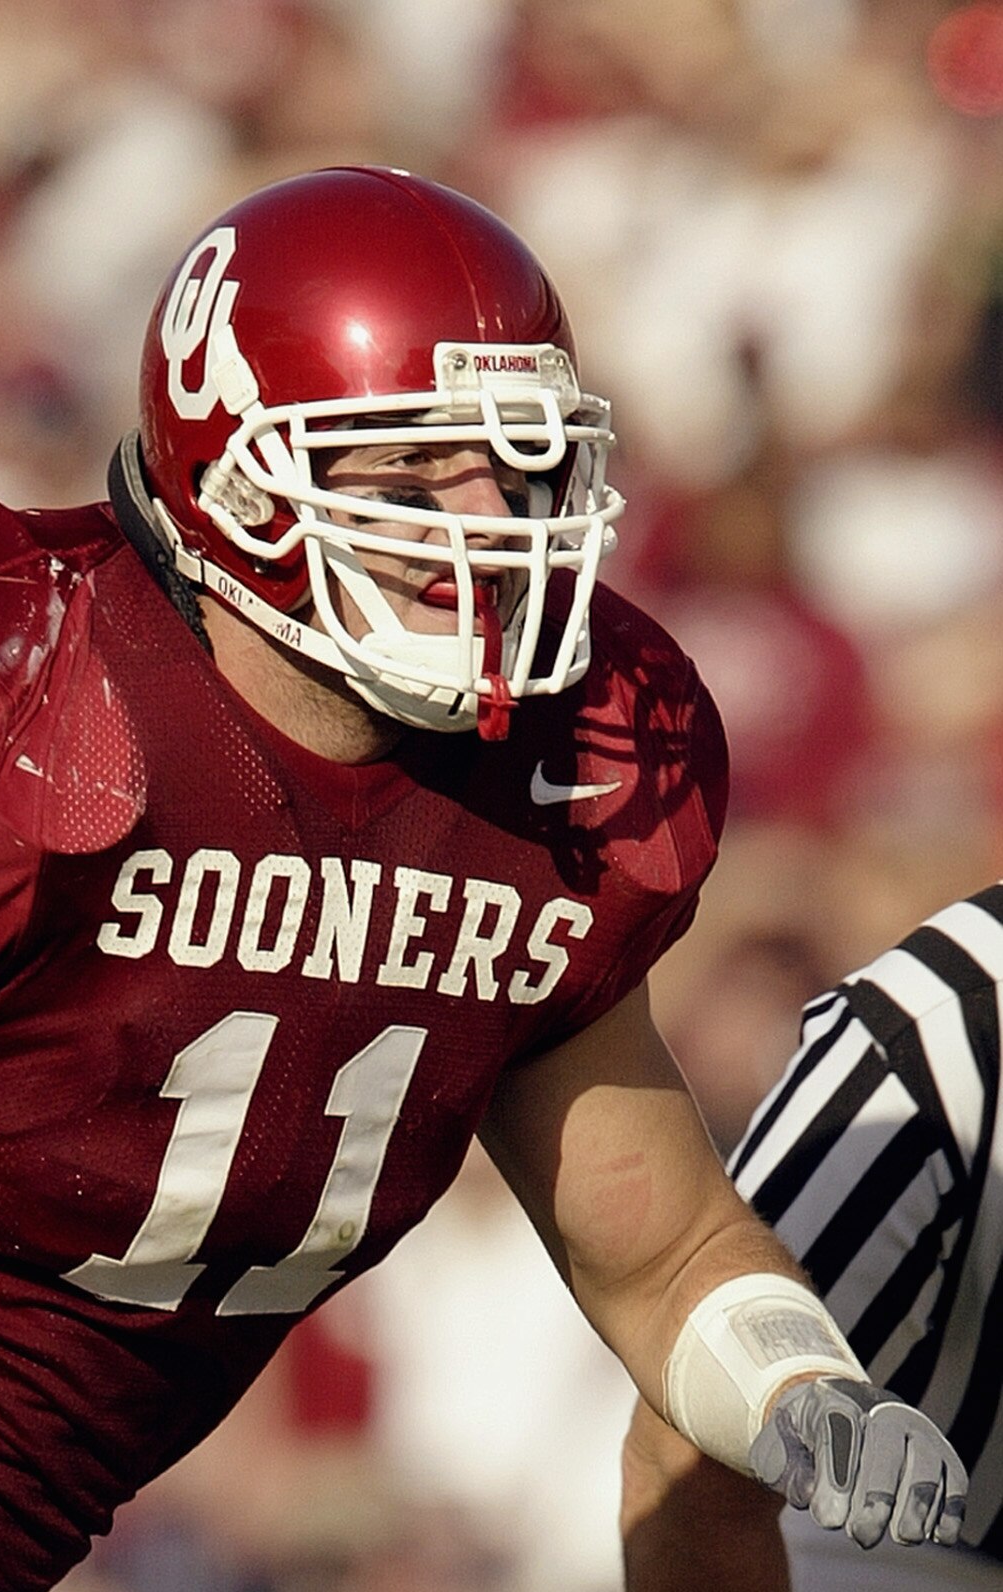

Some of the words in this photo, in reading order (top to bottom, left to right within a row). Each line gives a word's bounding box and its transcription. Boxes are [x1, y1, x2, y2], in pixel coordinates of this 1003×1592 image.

[161, 227, 240, 420] OU
[473, 355, 538, 373] OKLAHOMA
[97, 848, 594, 1004] SOONERS
[59, 1011, 428, 1316] 11
